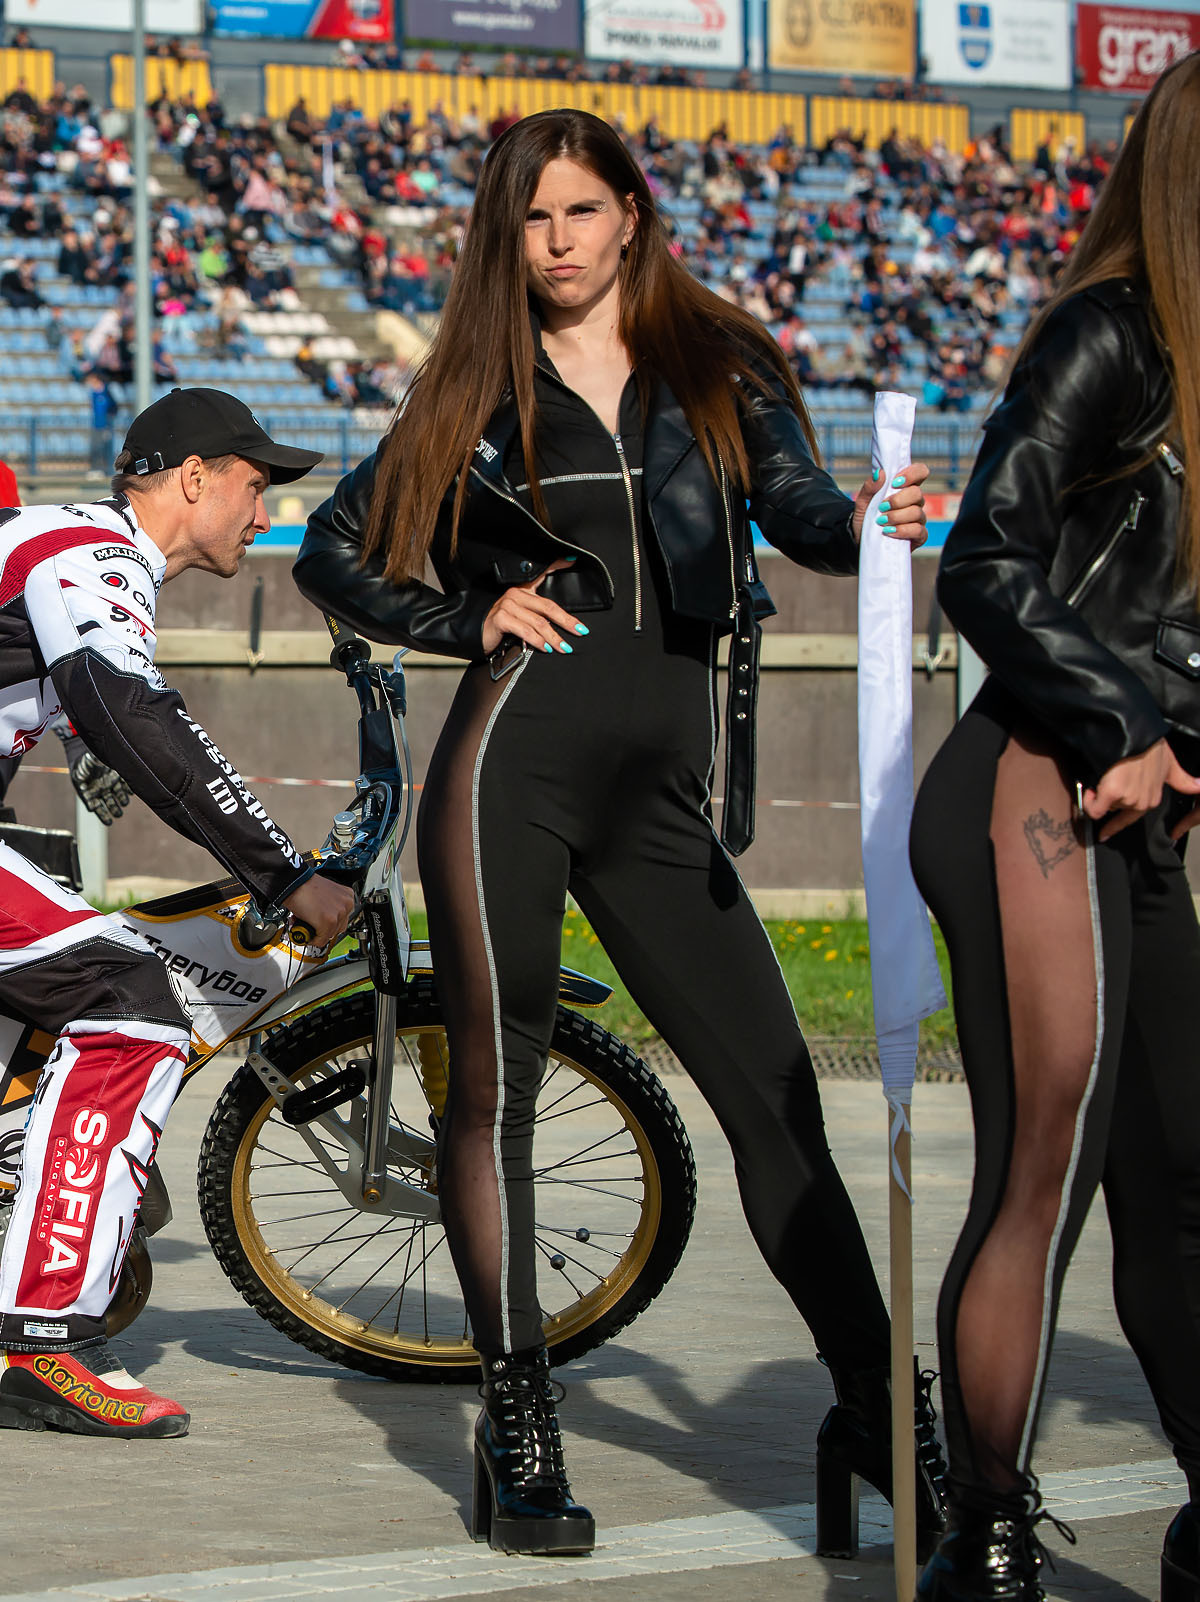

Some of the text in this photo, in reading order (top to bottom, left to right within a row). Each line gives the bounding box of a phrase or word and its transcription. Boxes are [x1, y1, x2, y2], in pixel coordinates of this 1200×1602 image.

[206, 776, 239, 815] LTD
[38, 1139, 65, 1240] DAUGAVPILS
[43, 1109, 109, 1274] SOFIA
[33, 1356, 147, 1424] daytona
